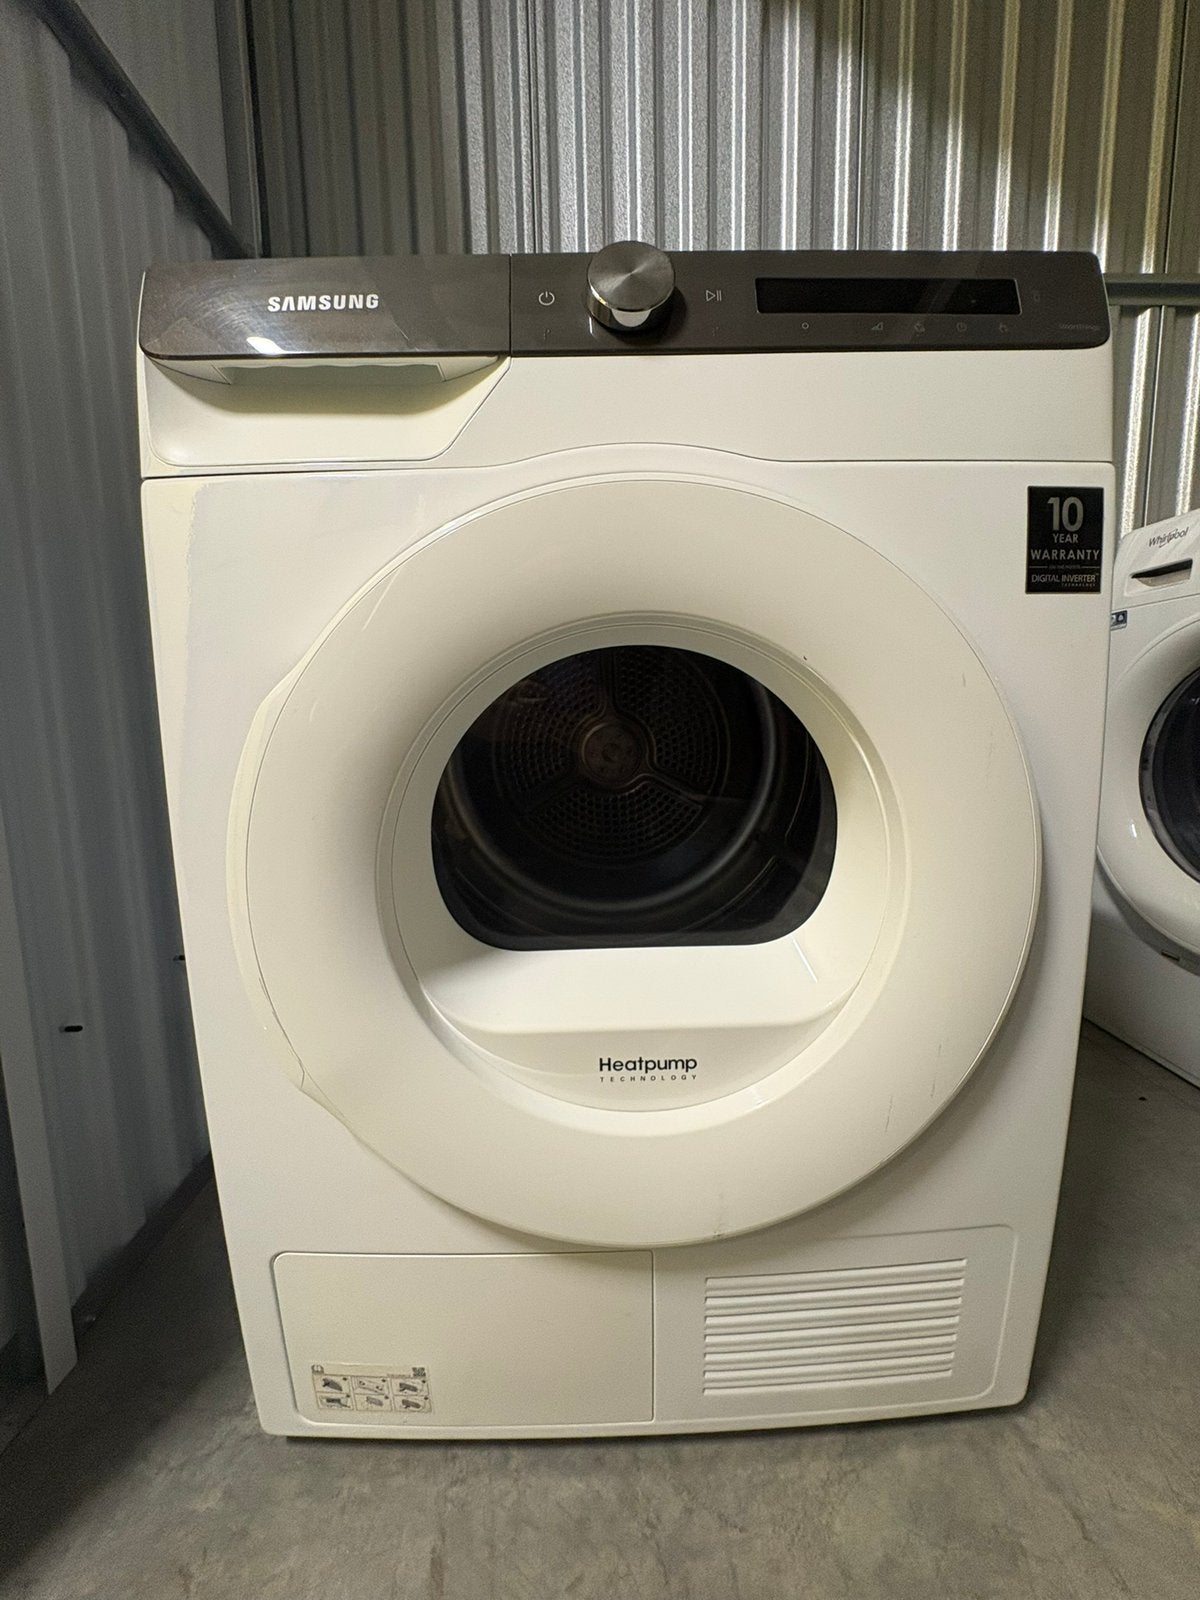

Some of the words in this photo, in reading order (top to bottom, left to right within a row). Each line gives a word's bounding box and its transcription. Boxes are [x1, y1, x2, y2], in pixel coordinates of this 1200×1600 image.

[267, 294, 379, 312] SAMSUNG
[1047, 496, 1084, 532] 10
[1052, 533, 1079, 543] YEAR
[1148, 526, 1189, 548] Whirlpool
[1030, 549, 1100, 560] WARRANTY
[1031, 574, 1060, 583] DIGITAL
[1061, 573, 1096, 582] INVERTER
[599, 1056, 698, 1074] Heatpump
[600, 1074, 697, 1082] TECHNOLOGY
